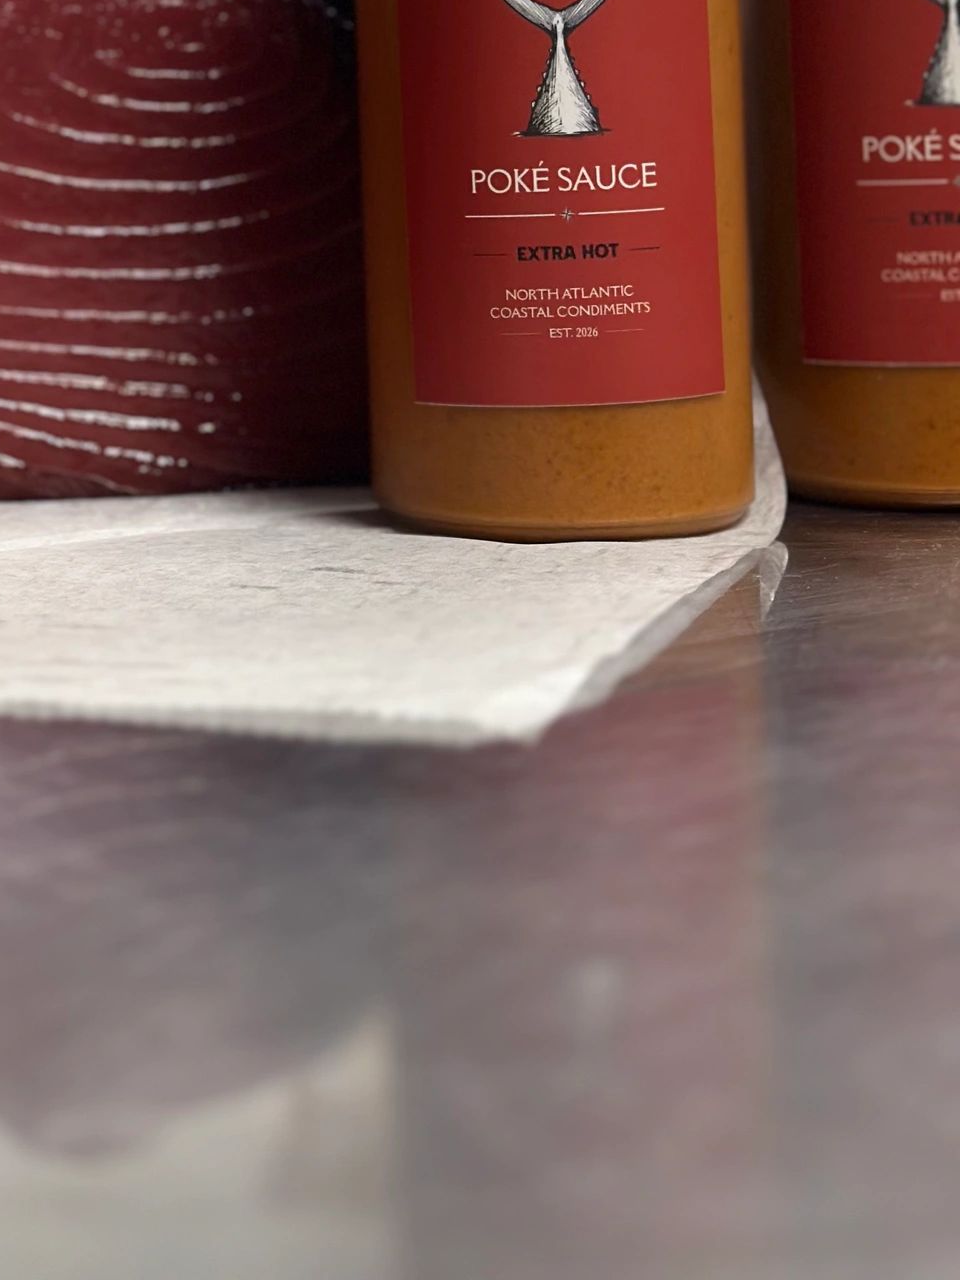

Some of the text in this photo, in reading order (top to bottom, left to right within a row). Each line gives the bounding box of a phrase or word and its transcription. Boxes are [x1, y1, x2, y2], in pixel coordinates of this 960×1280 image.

[862, 128, 943, 163] POKÉ
[471, 160, 657, 193] POKÉ SAUCE
[517, 243, 619, 261] EXTRA HOT
[505, 285, 634, 301] NORTH ATLANTIC
[490, 301, 651, 319] COASTAL CONDIMENTS
[549, 327, 599, 339] EST. 2026
